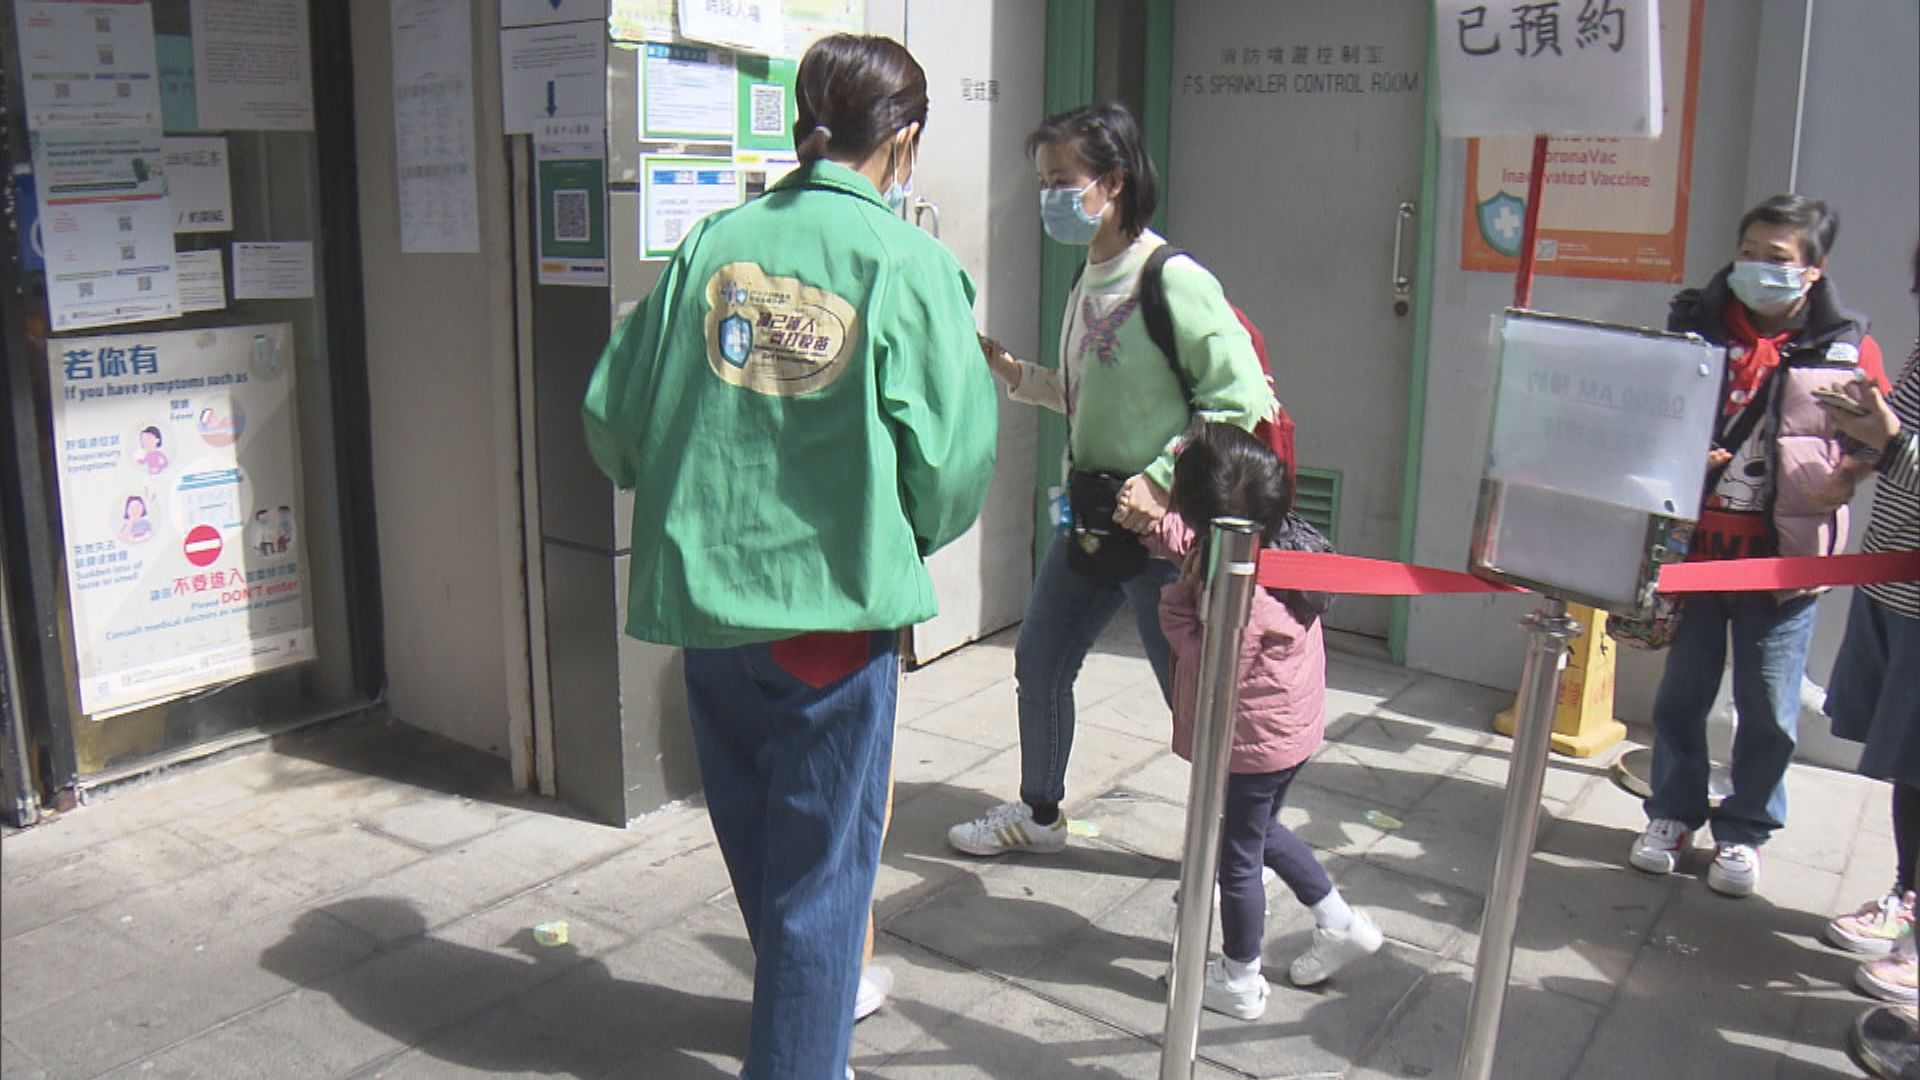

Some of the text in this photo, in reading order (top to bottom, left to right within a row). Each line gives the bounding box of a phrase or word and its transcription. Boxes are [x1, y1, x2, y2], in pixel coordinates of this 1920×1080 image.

[1458, 0, 1625, 57] 已預約
[1210, 75, 1288, 94] SPRINKLER
[1294, 74, 1365, 93] CONTROL
[1371, 73, 1419, 92] ROOM
[1544, 149, 1617, 164] oronaVac
[1590, 170, 1650, 187] Vaccine
[63, 344, 159, 381] 若你有
[64, 372, 248, 400] If you have symptoms such as
[171, 567, 246, 597] 不要進入
[221, 585, 262, 604] DON'T
[266, 580, 298, 596] enter
[105, 624, 143, 641] Consult
